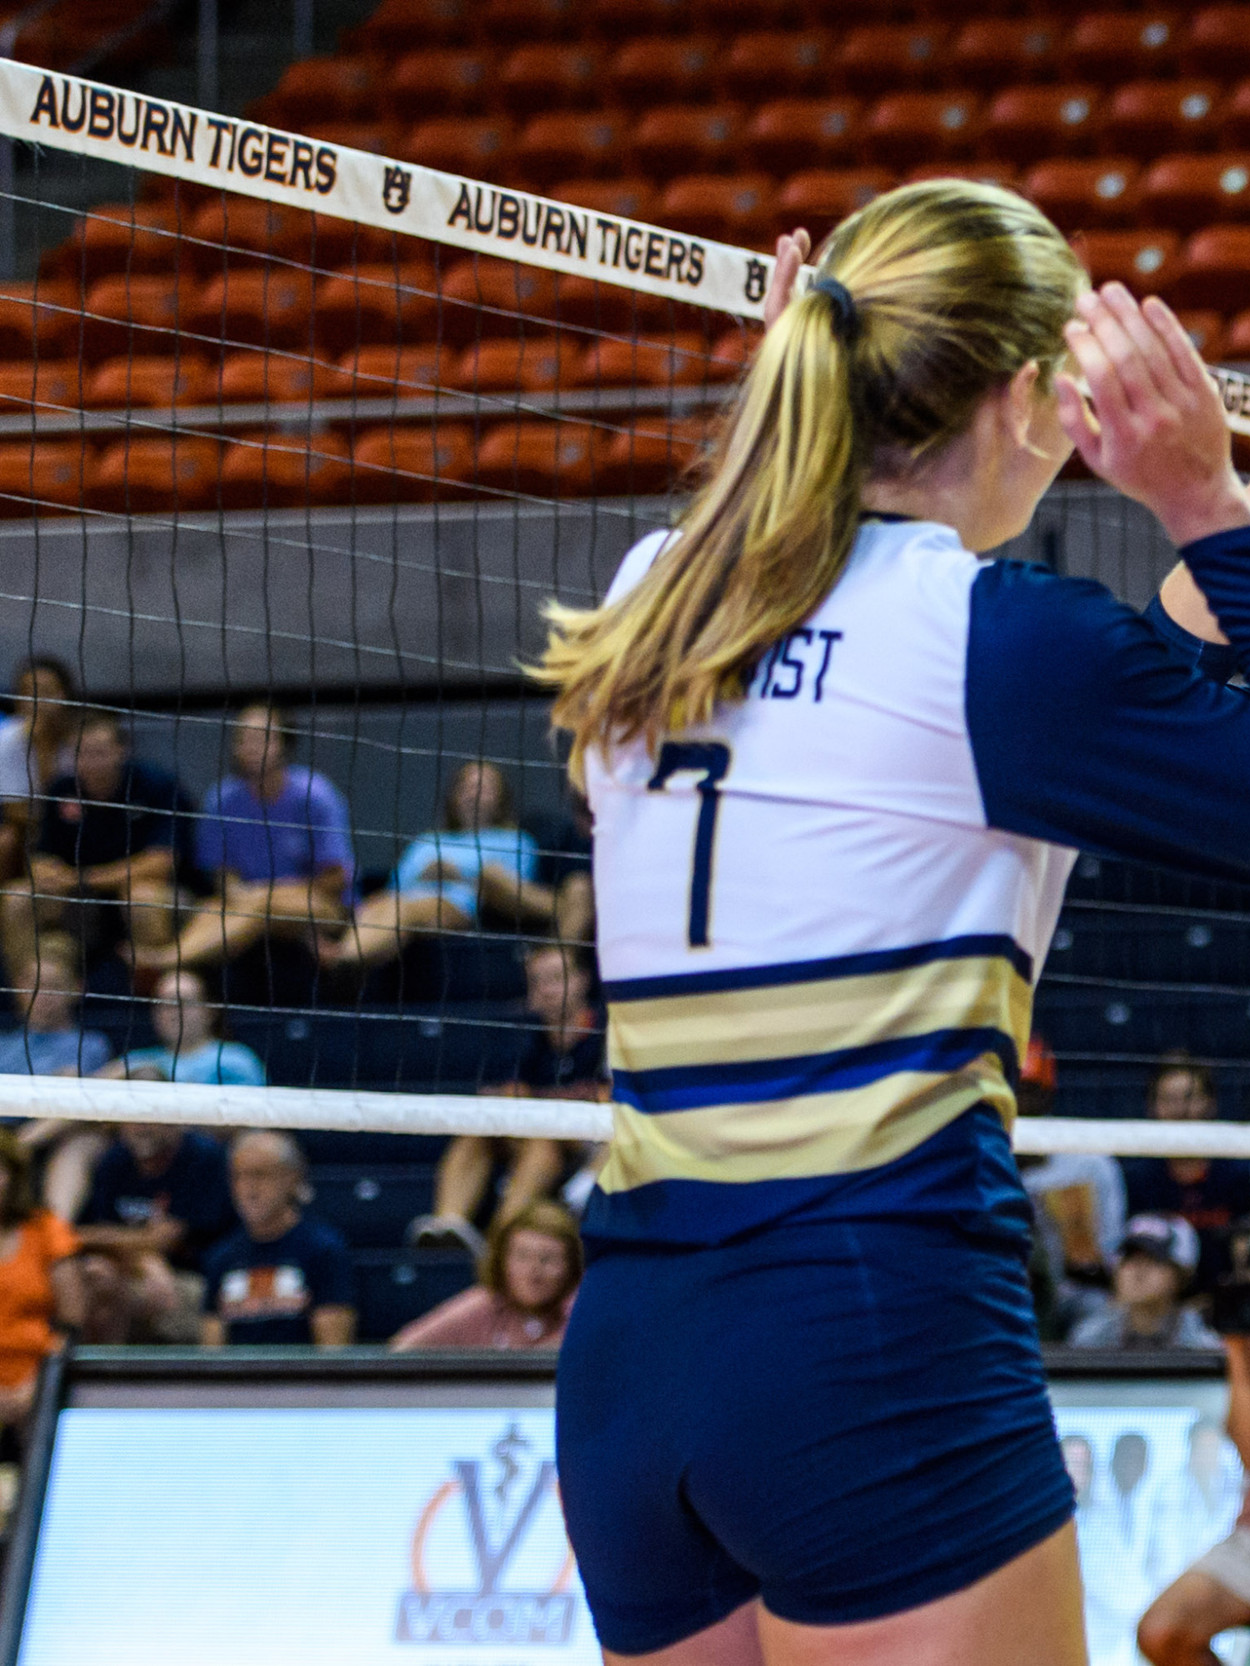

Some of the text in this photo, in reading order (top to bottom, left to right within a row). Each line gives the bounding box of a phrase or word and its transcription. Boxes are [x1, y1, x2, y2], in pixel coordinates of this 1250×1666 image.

[30, 75, 198, 162] AUBURN
[206, 118, 338, 195] TIGERS
[448, 183, 588, 259] AUBURN
[597, 218, 706, 286] TIGERS
[646, 737, 732, 952] 7
